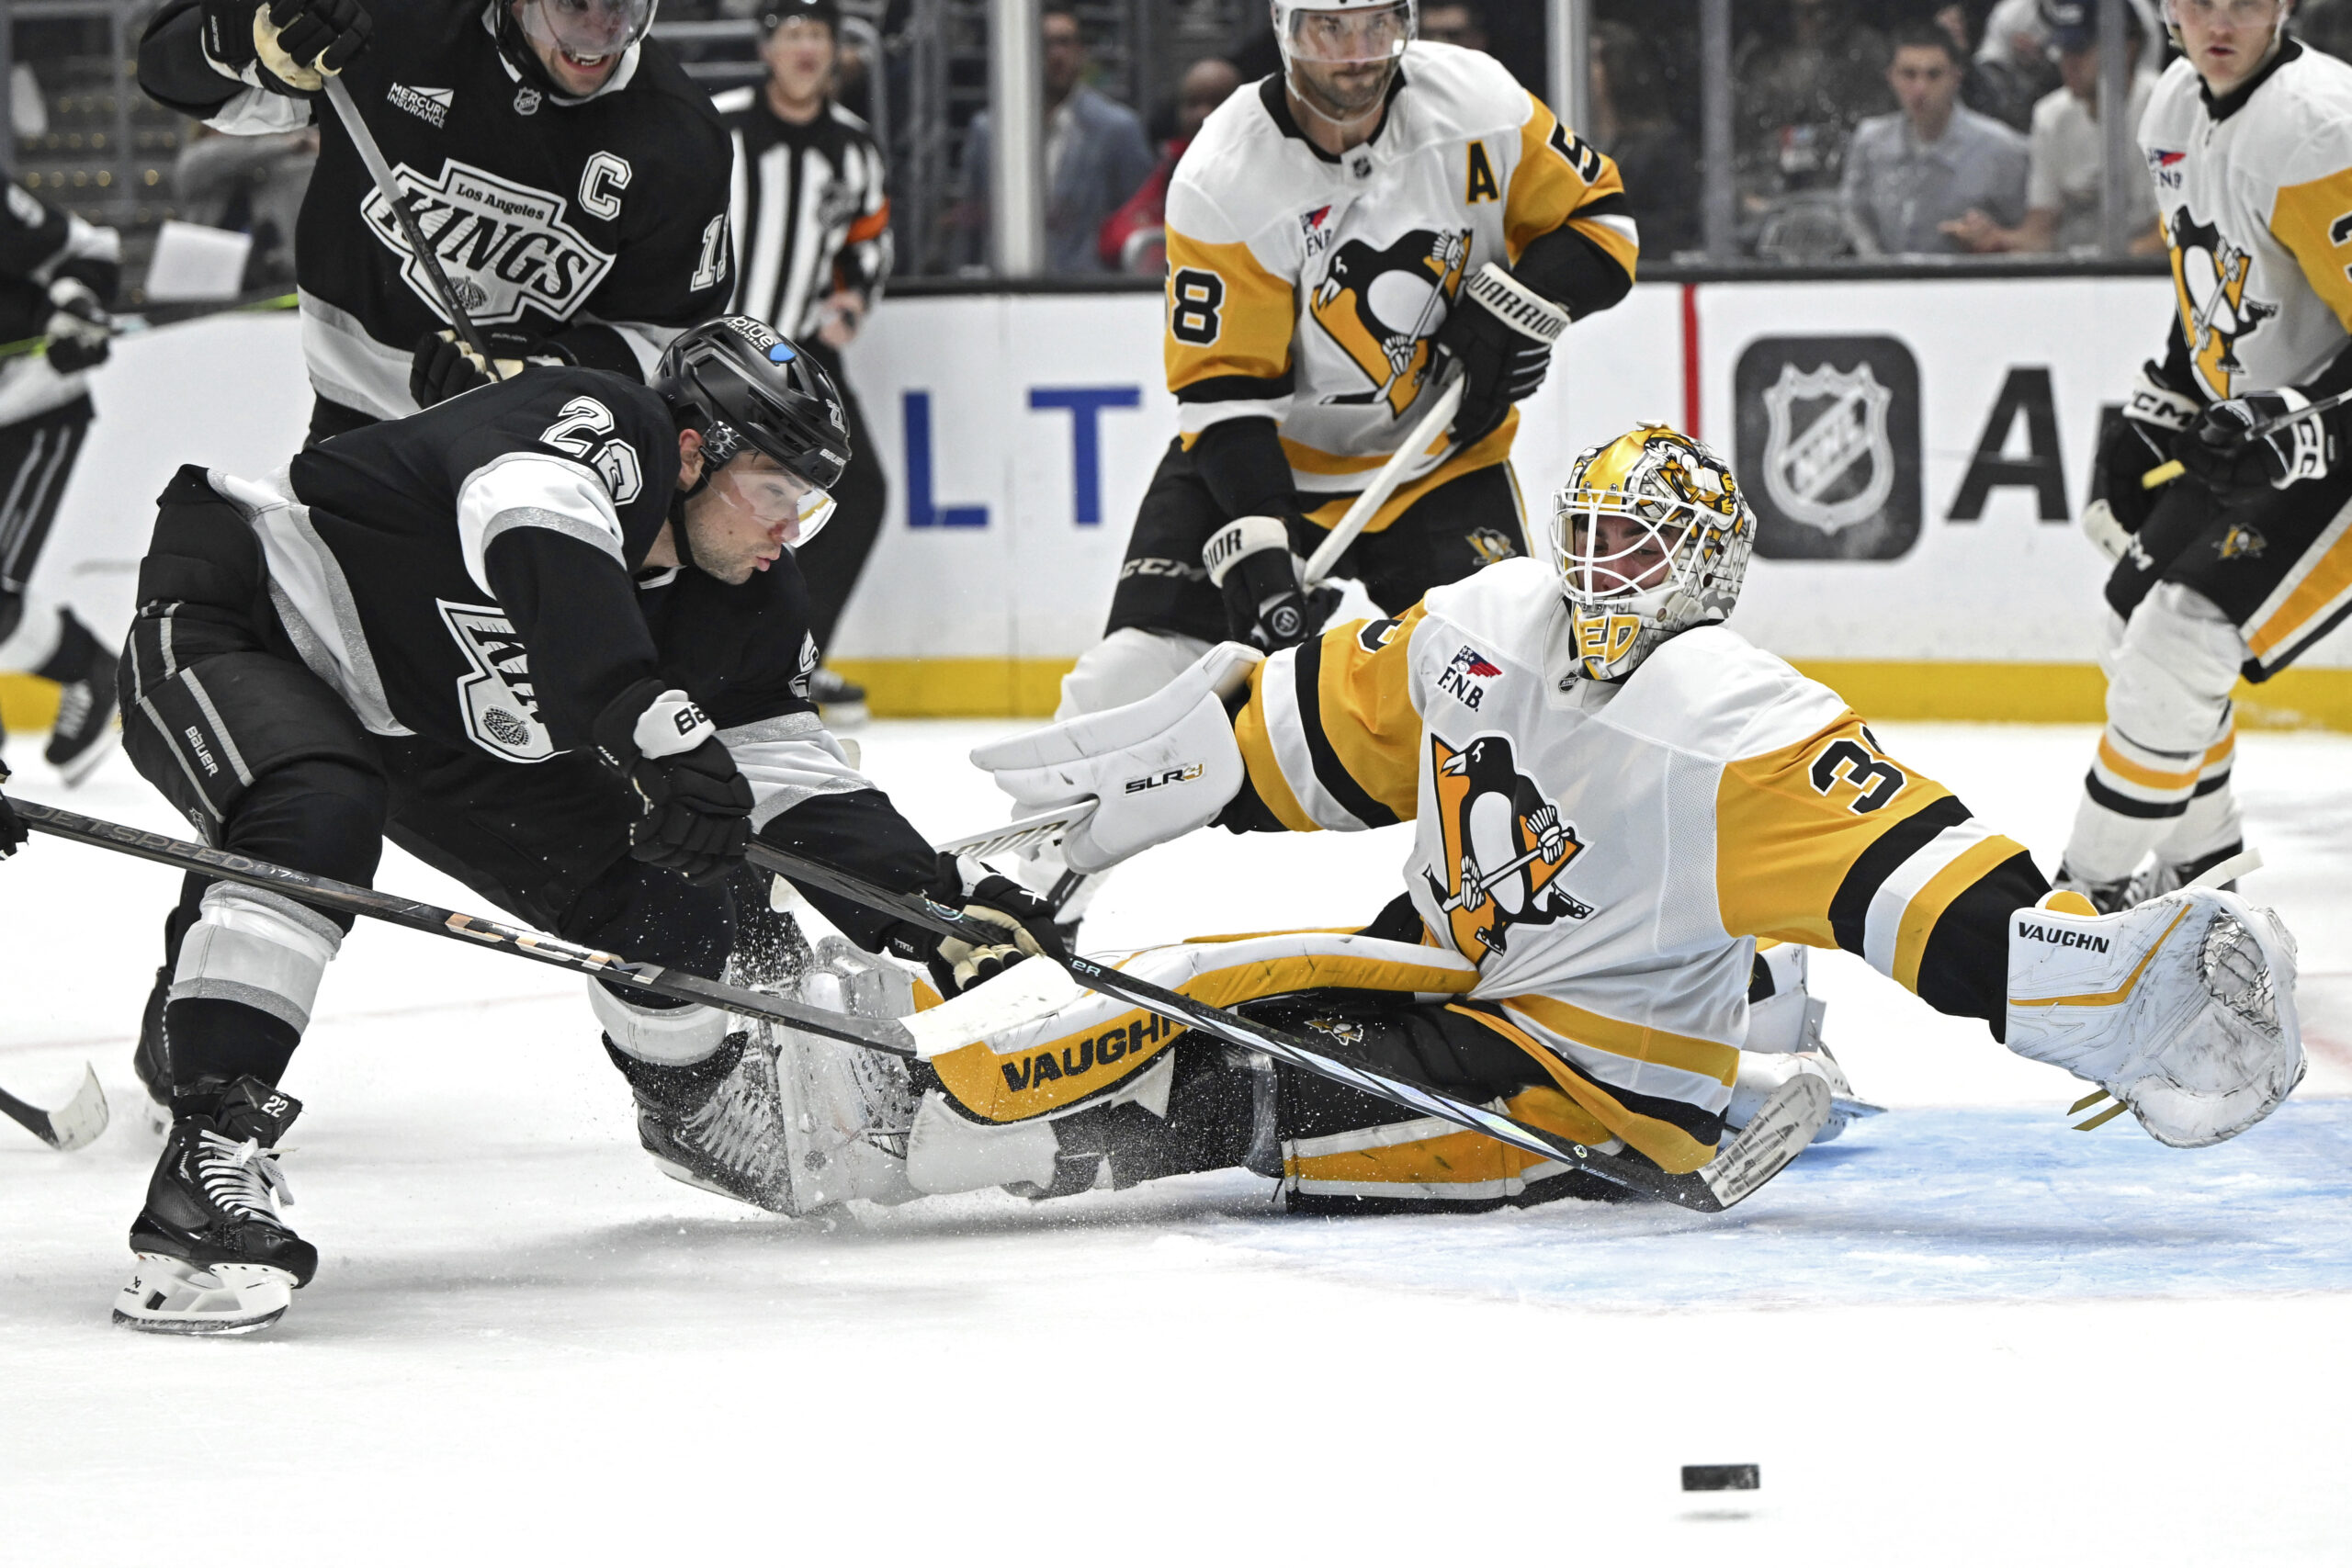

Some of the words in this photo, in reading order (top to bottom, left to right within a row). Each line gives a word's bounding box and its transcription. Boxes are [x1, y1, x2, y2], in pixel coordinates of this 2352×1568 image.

[387, 92, 446, 130] INSURANCE
[390, 82, 448, 118] MERCURY
[578, 150, 633, 221] C
[1466, 140, 1500, 206] A
[456, 183, 483, 200] Los
[484, 191, 546, 220] Angeles
[377, 186, 590, 300] KINGS
[733, 315, 775, 347] blue
[2132, 389, 2194, 428] CM
[22, 806, 253, 872] JETSPEED
[2018, 921, 2110, 954] VAUGHN
[261, 1094, 289, 1118] 22
